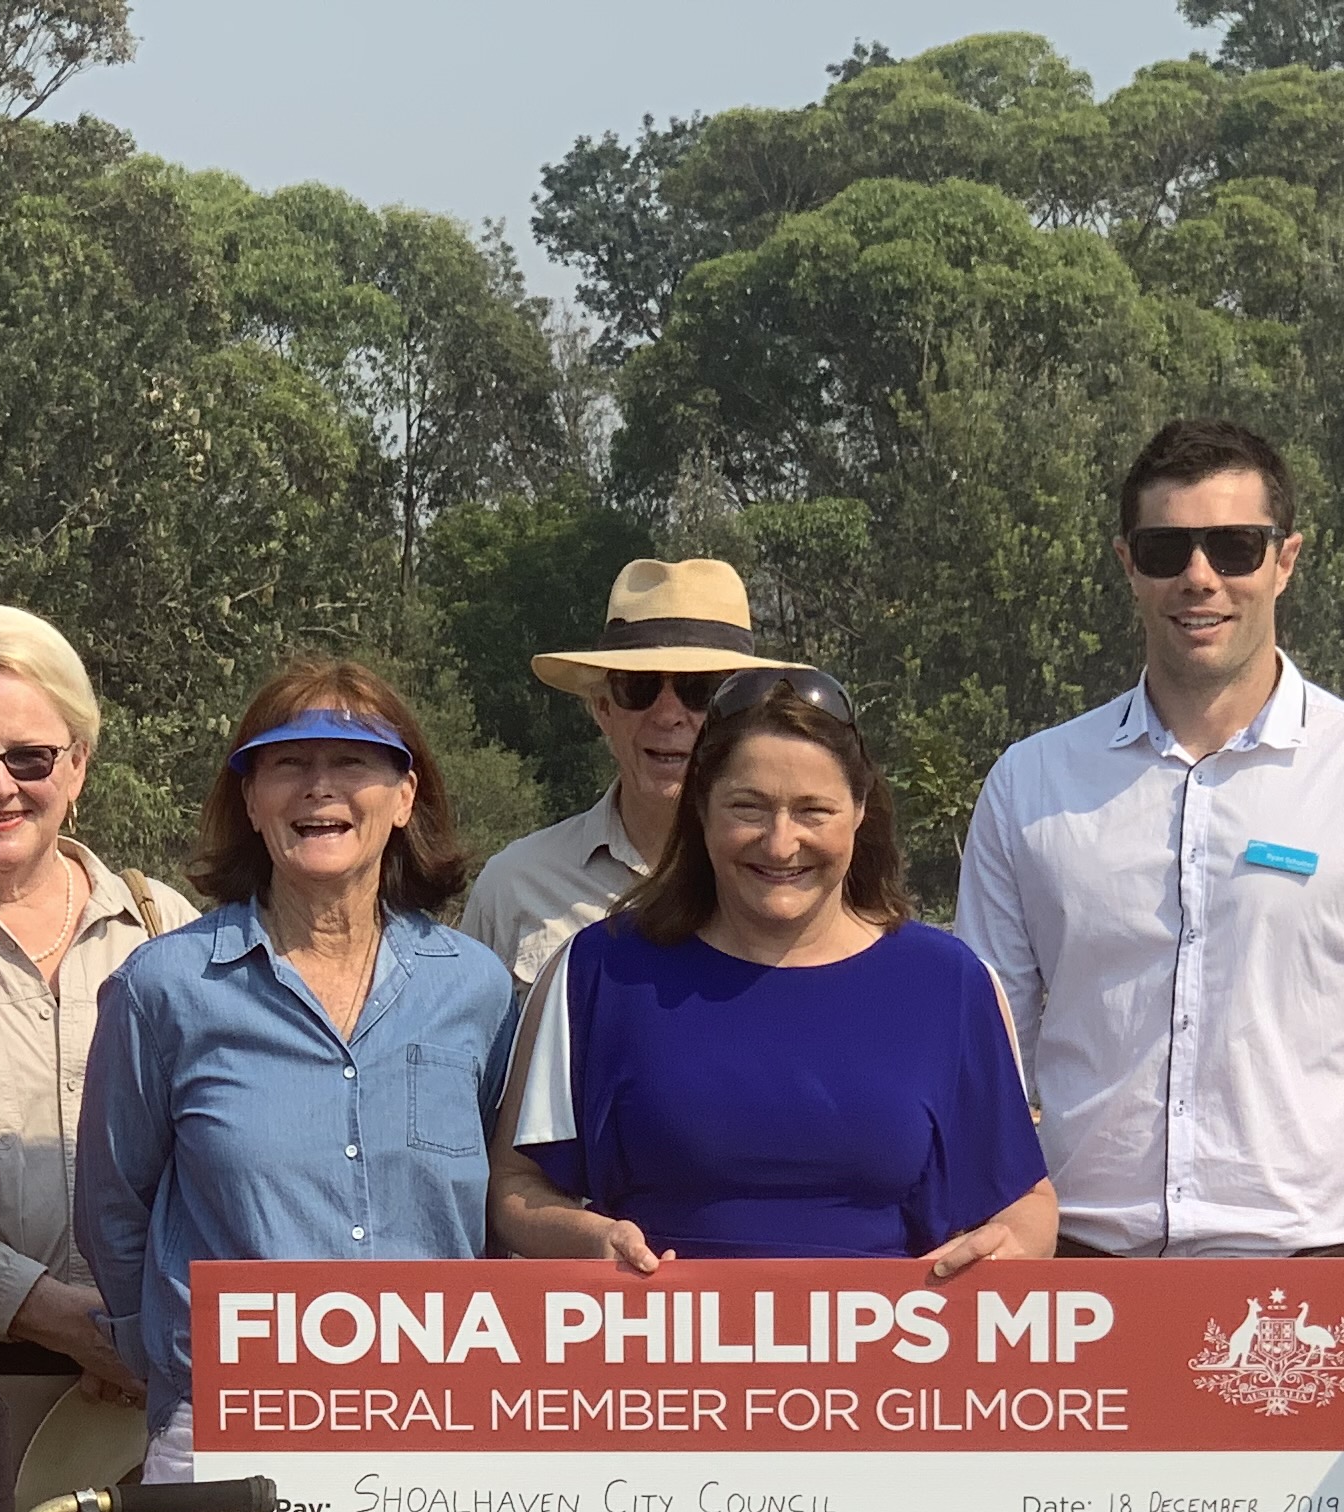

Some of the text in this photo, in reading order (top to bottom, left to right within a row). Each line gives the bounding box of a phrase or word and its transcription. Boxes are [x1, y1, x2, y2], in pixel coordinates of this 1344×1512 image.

[218, 1290, 1115, 1365] FIONA PHILLIPS MP
[219, 1388, 1129, 1431] FEDERAL MEMBER FOR GILMORE
[1246, 1389, 1307, 1401] AUSTRALIA
